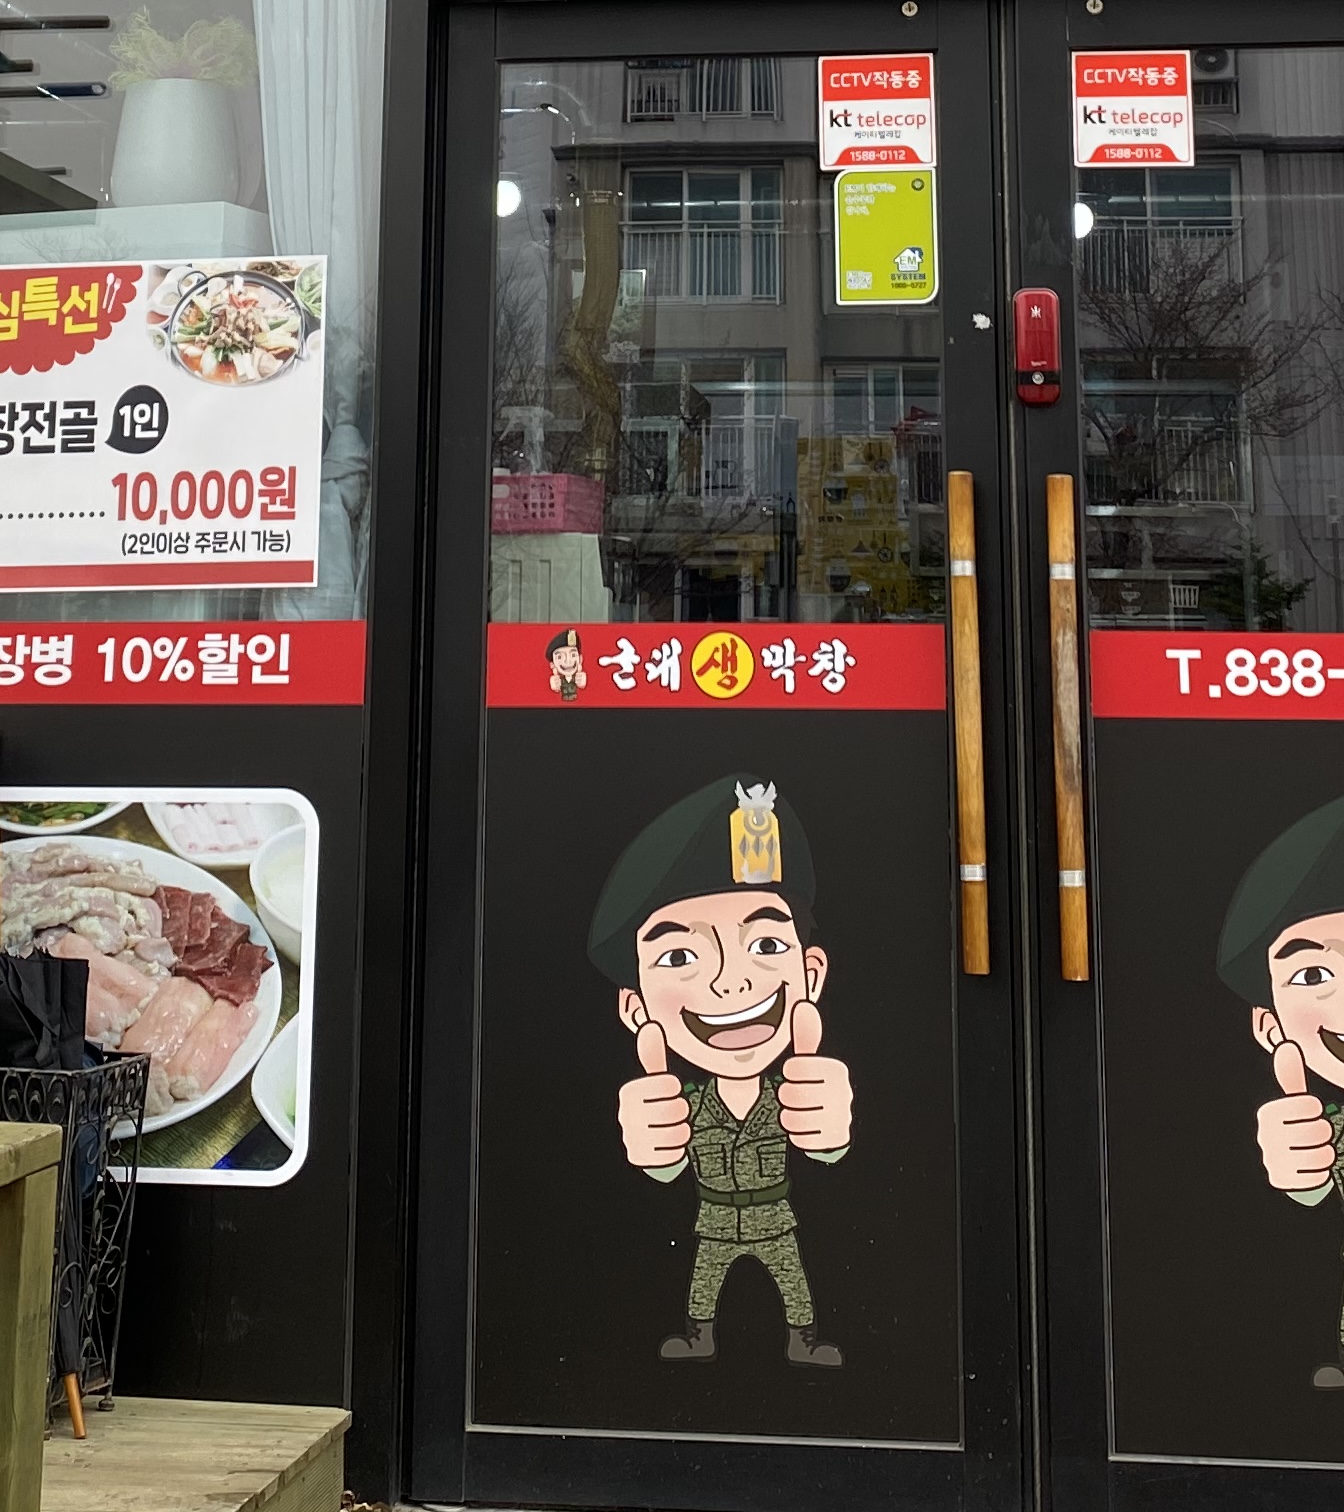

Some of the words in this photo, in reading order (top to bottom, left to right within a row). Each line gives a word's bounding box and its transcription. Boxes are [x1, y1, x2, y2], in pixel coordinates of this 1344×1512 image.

[830, 70, 923, 89] CCTV작동중
[1084, 67, 1179, 86] CCTV작동중
[829, 109, 852, 128] kt
[857, 111, 926, 129] telecop
[1083, 105, 1106, 124] kt
[1111, 108, 1183, 128] telecop
[849, 150, 906, 161] 1588-0112
[1104, 148, 1163, 159] 1588-0112
[117, 402, 160, 440] 1인
[110, 465, 298, 526] 10,000원
[121, 531, 191, 556] (2인이상
[194, 530, 246, 554] 주문시
[250, 529, 292, 553] 가능)
[97, 632, 291, 685] 10%할인
